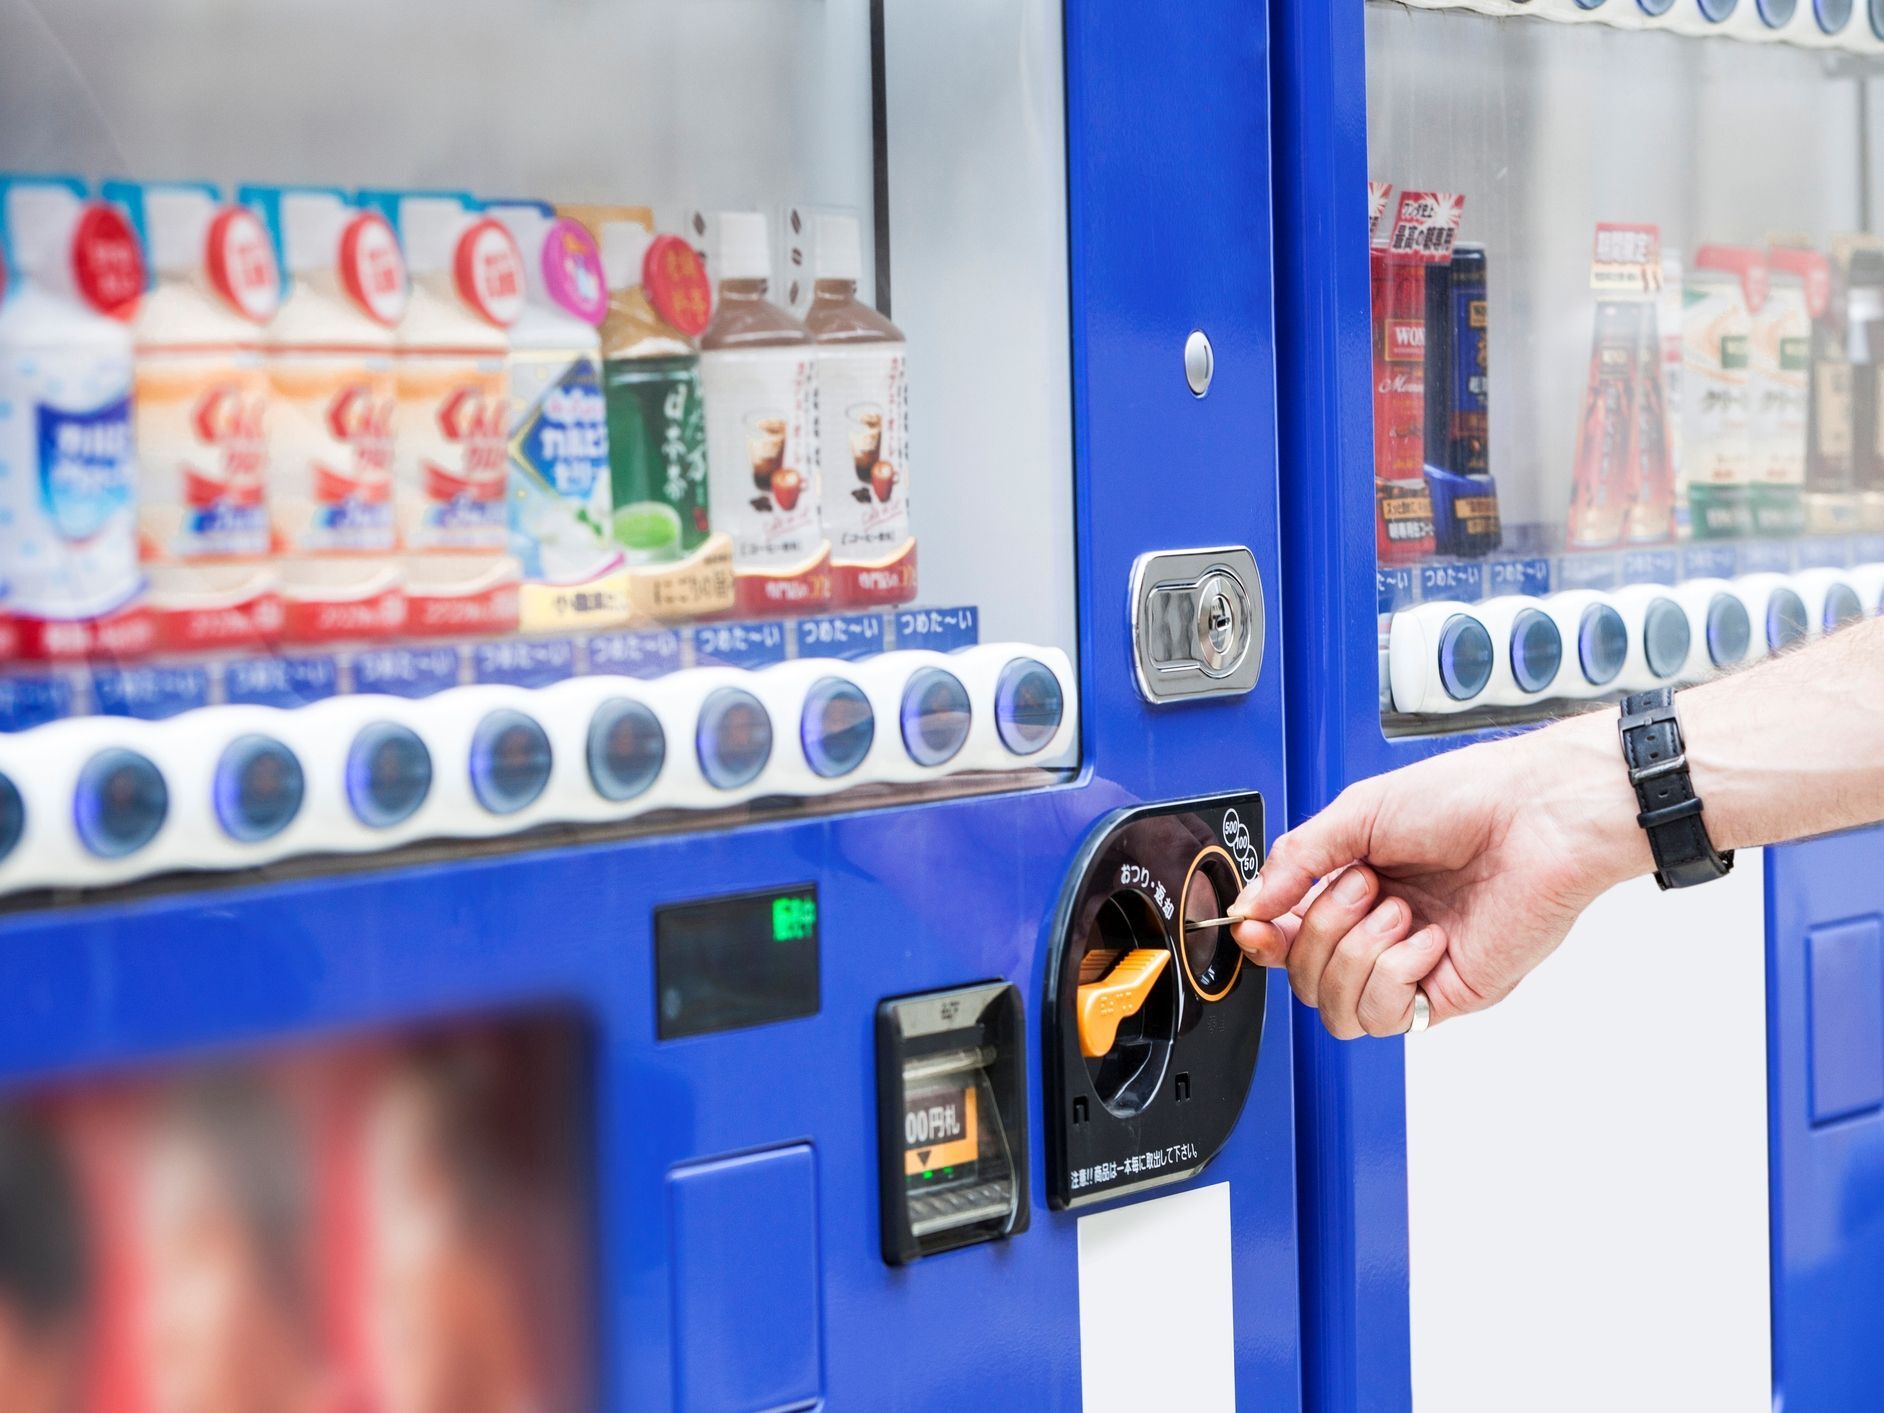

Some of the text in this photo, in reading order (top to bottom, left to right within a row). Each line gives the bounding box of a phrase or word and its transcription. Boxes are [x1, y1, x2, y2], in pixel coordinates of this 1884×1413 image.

[901, 610, 972, 635] つめた〜い
[1224, 819, 1238, 835] 500
[1236, 835, 1248, 850] 100
[1244, 856, 1255, 871] 50
[1121, 864, 1175, 920] おつり・返却
